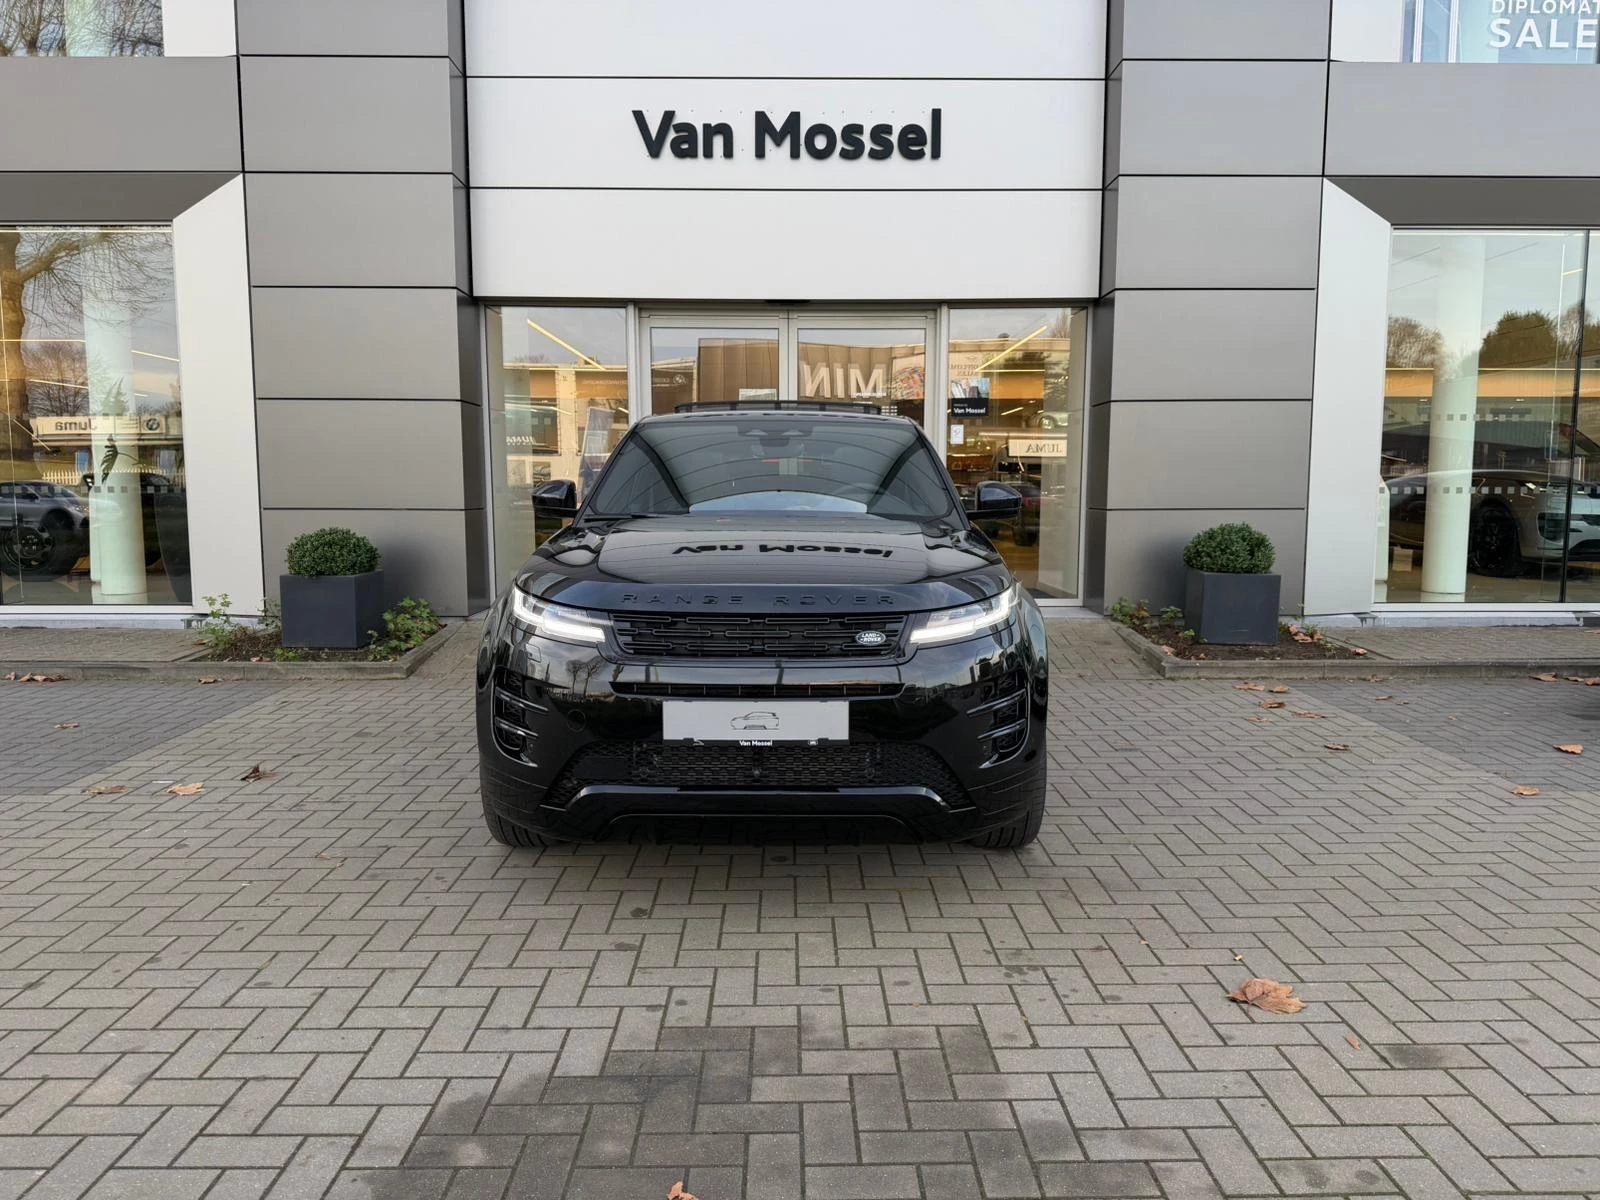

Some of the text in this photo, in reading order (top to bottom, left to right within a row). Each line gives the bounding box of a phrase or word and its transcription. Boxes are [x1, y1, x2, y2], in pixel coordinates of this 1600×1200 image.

[1489, 18, 1598, 48] SALE
[631, 108, 943, 160] Van Mossel
[622, 594, 894, 605] RANGE ROVER
